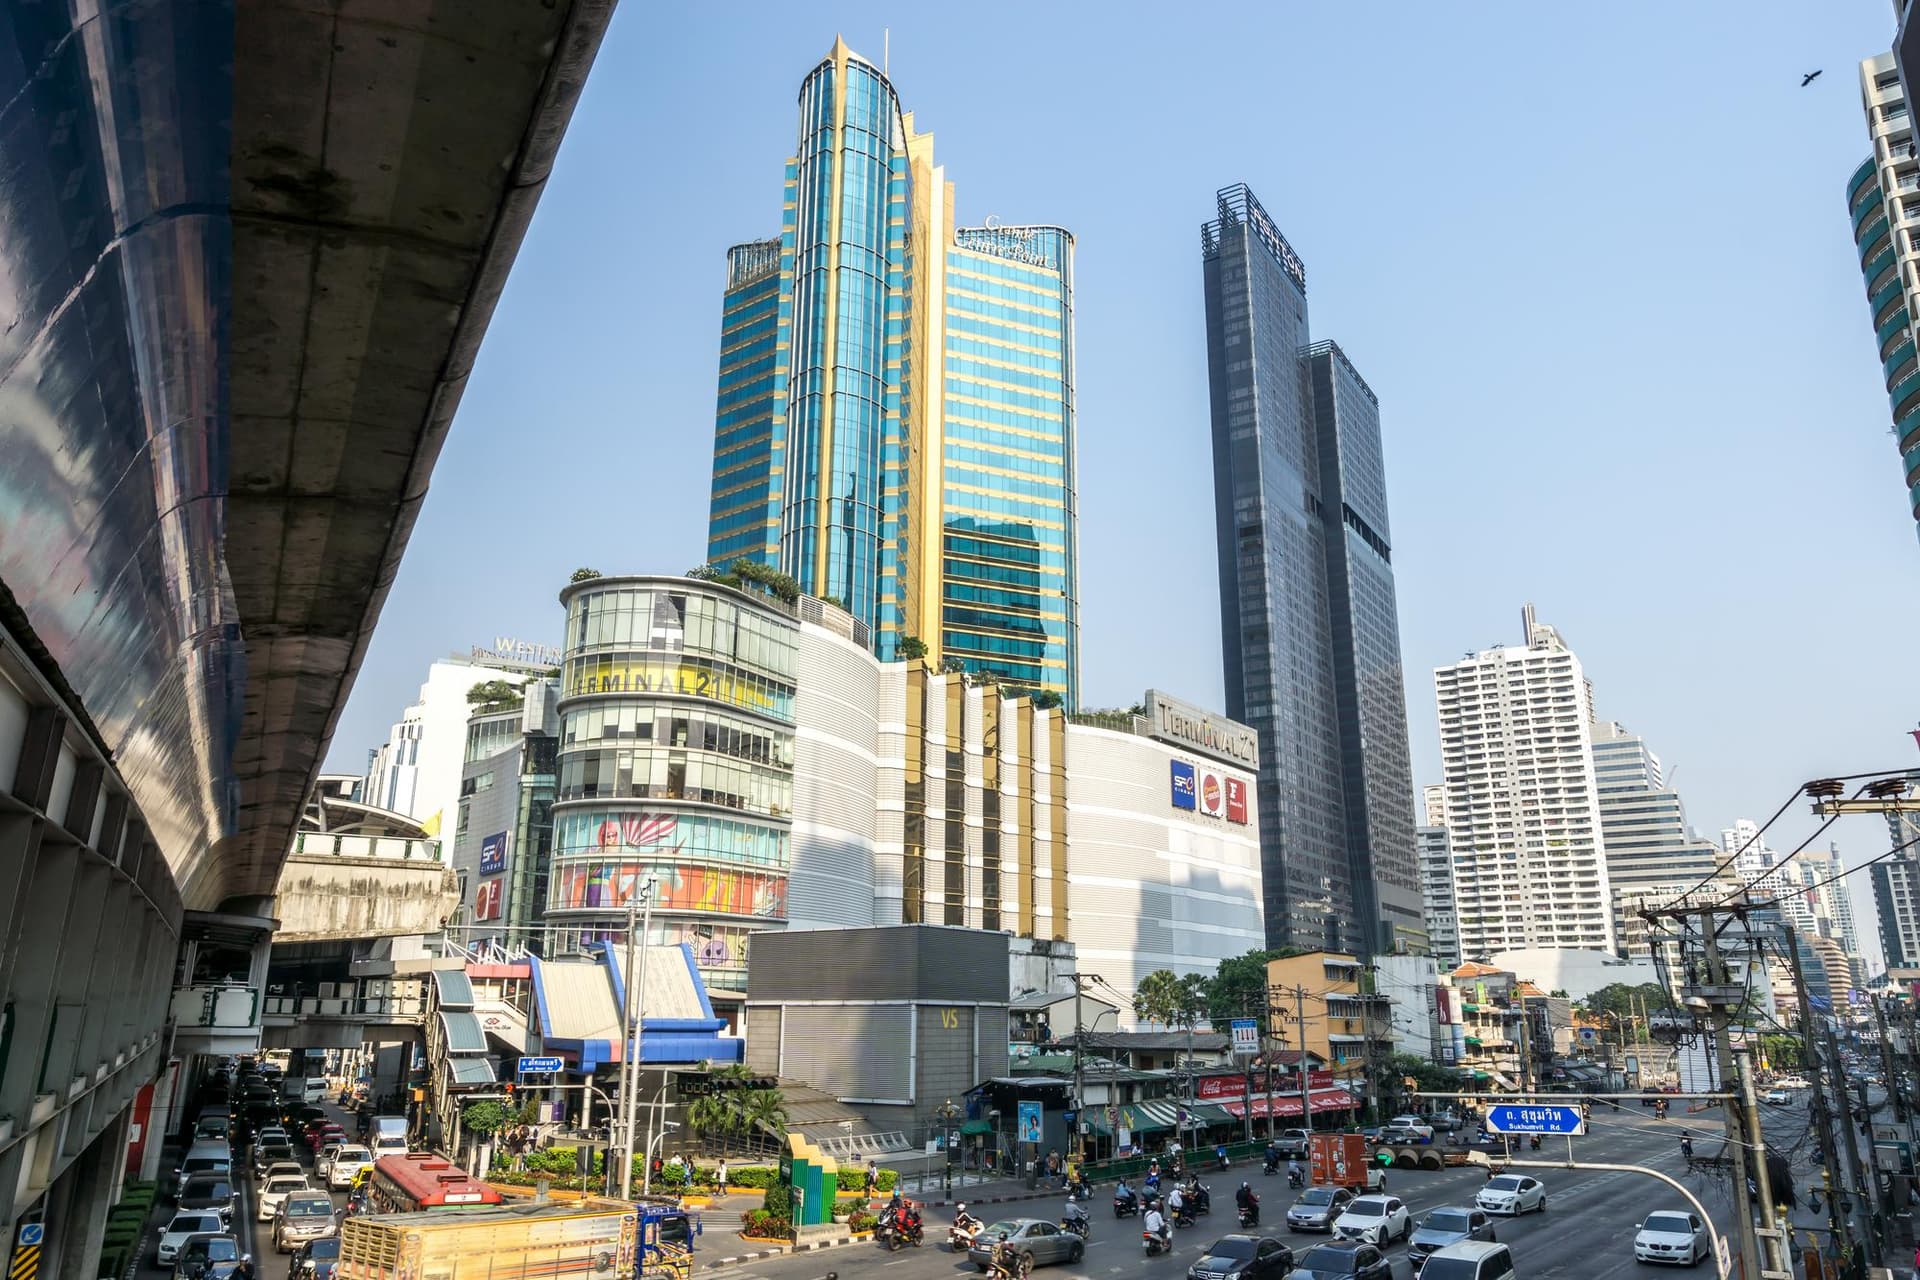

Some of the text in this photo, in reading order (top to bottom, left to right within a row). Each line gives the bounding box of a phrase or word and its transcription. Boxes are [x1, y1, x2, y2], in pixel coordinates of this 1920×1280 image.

[1254, 208, 1303, 281] ASHTON
[941, 1007, 958, 1029] VS
[1506, 1107, 1561, 1123] ถ. สุขุมวิท
[1508, 1123, 1545, 1131] Sukhumvit
